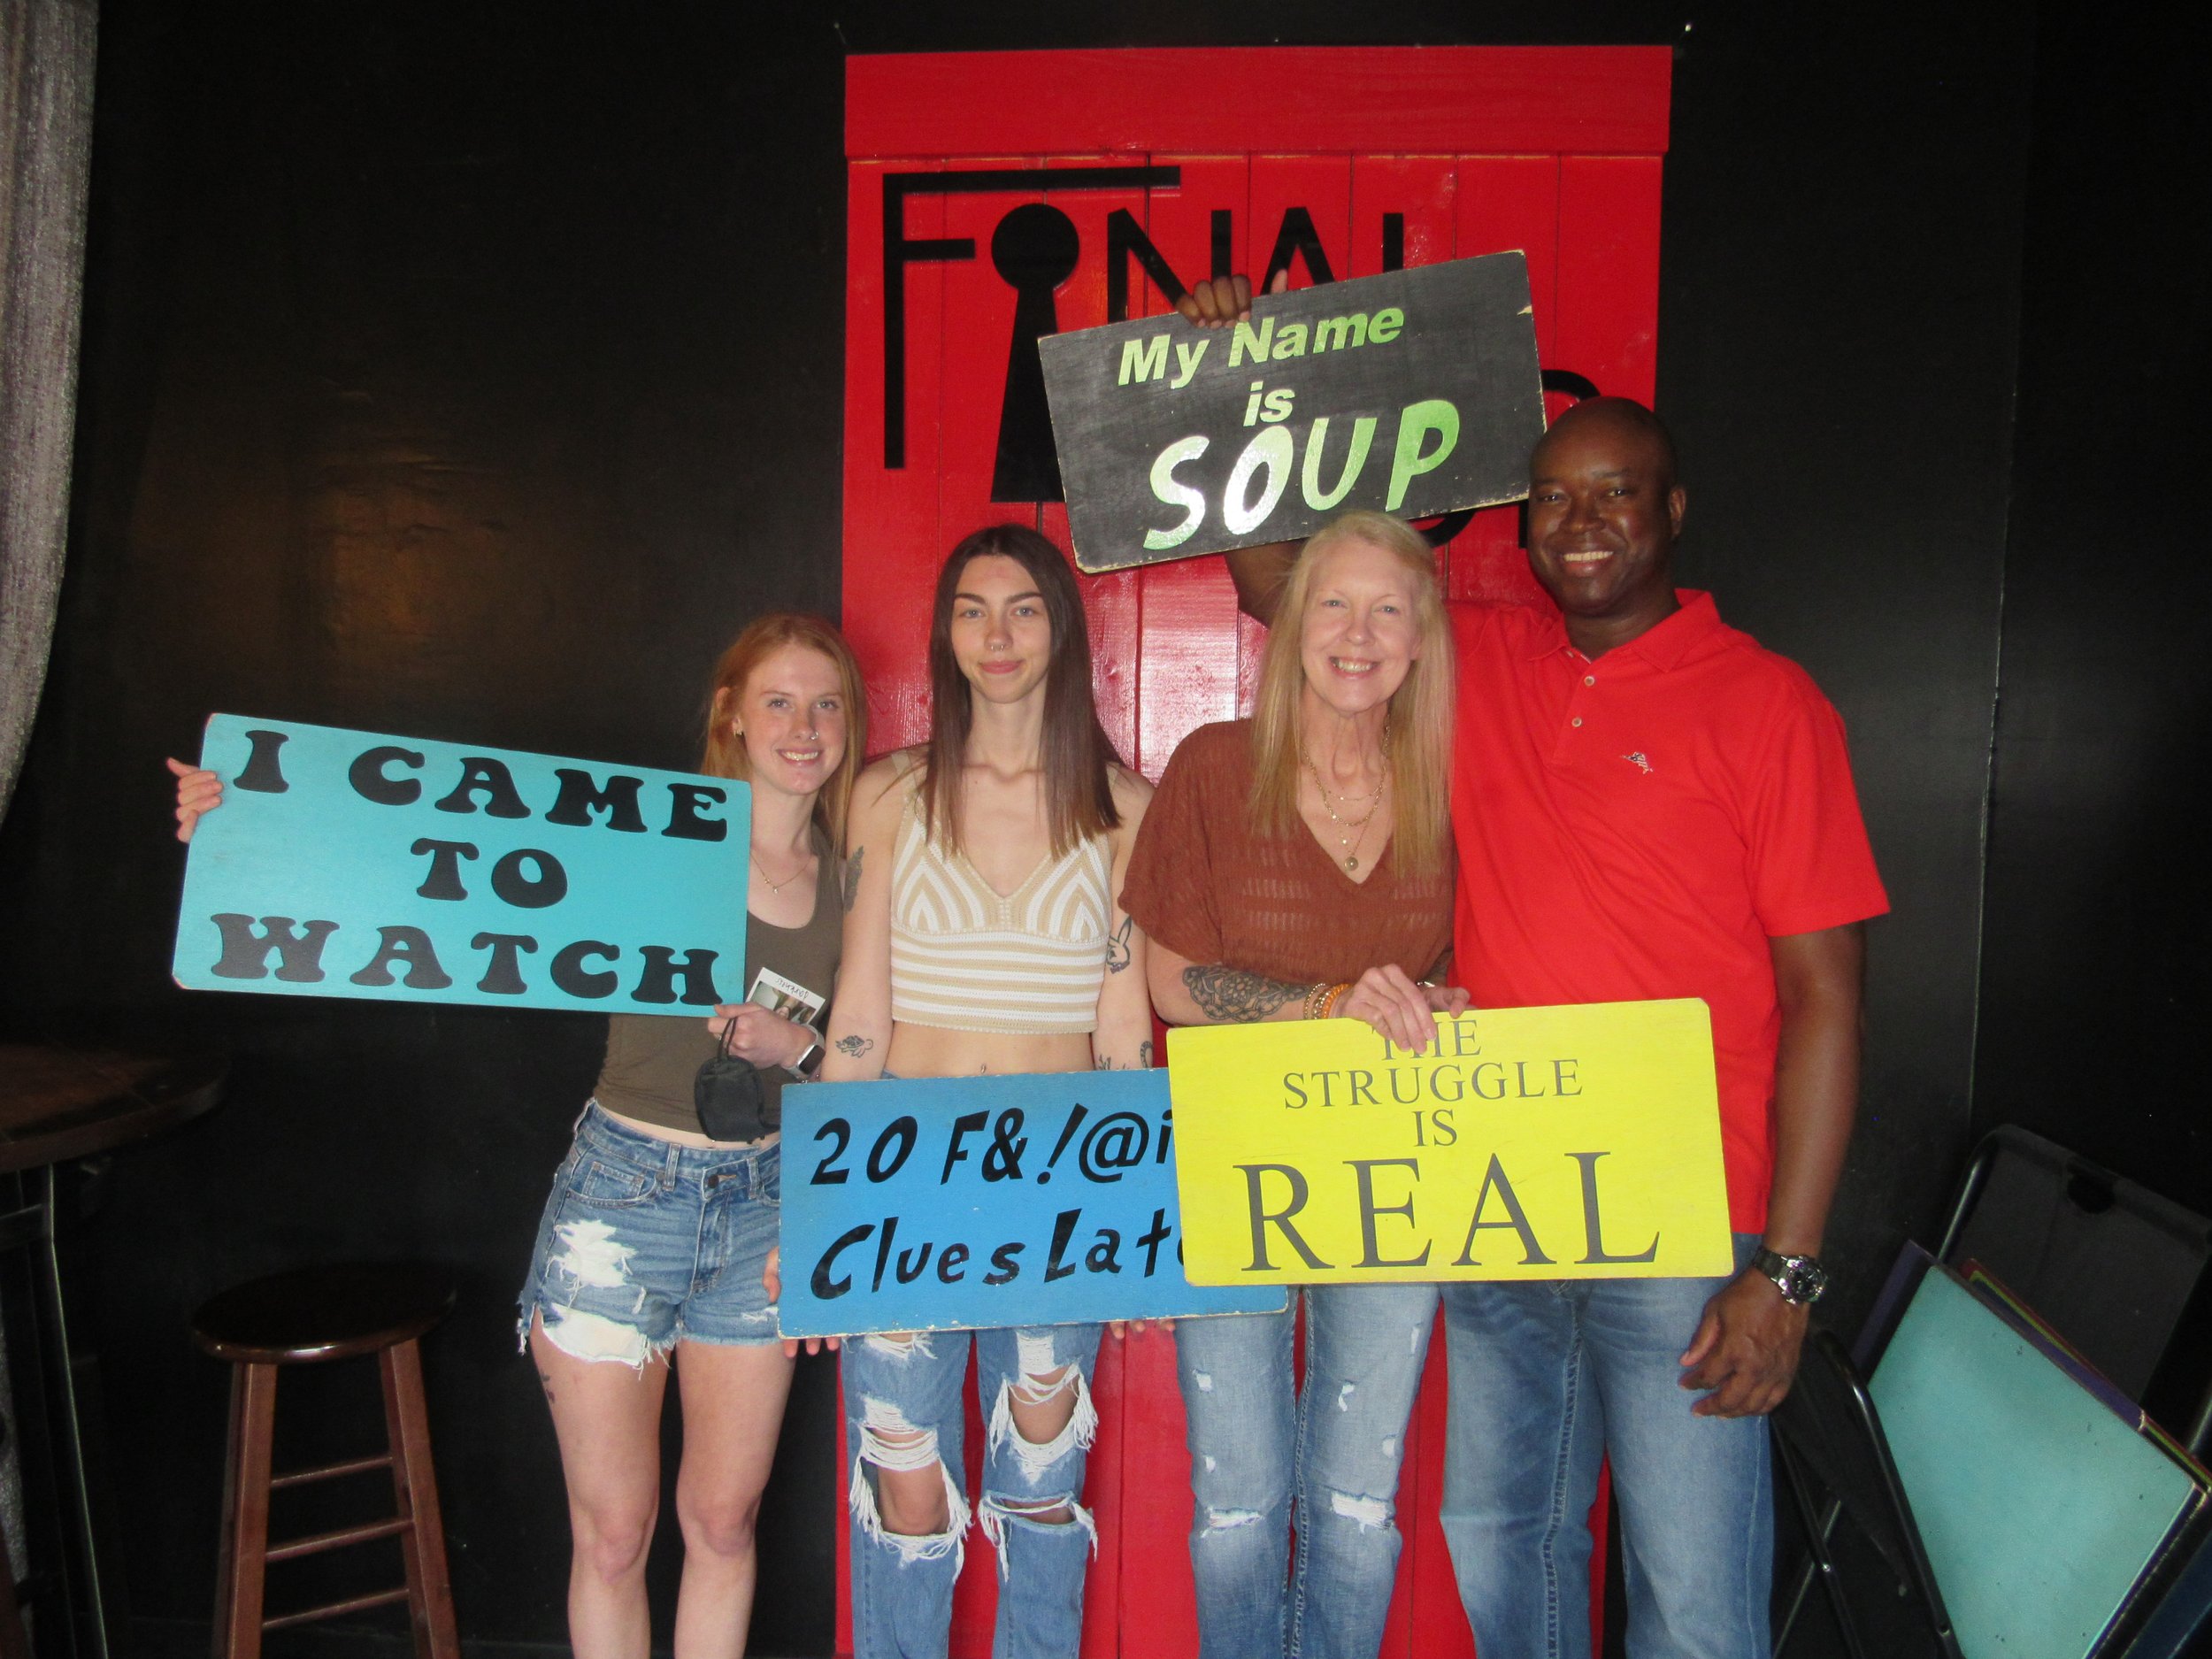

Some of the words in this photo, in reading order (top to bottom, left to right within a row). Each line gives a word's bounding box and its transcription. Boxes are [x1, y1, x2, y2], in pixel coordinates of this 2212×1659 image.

[1118, 334, 1210, 389] My
[1227, 307, 1405, 368] Name
[1242, 380, 1296, 427] is
[1142, 398, 1461, 550] SOUP
[233, 729, 290, 794] I
[348, 745, 728, 842] CAME
[410, 837, 568, 910] TO
[210, 912, 724, 1007] WATCH
[1283, 1058, 1584, 1110] STRUGGLE
[810, 1116, 918, 1186] 20
[1412, 1109, 1458, 1148] IS
[1232, 1151, 1661, 1272] REAL
[810, 1216, 1025, 1301] Clues
[1043, 1208, 1184, 1283] Lat
